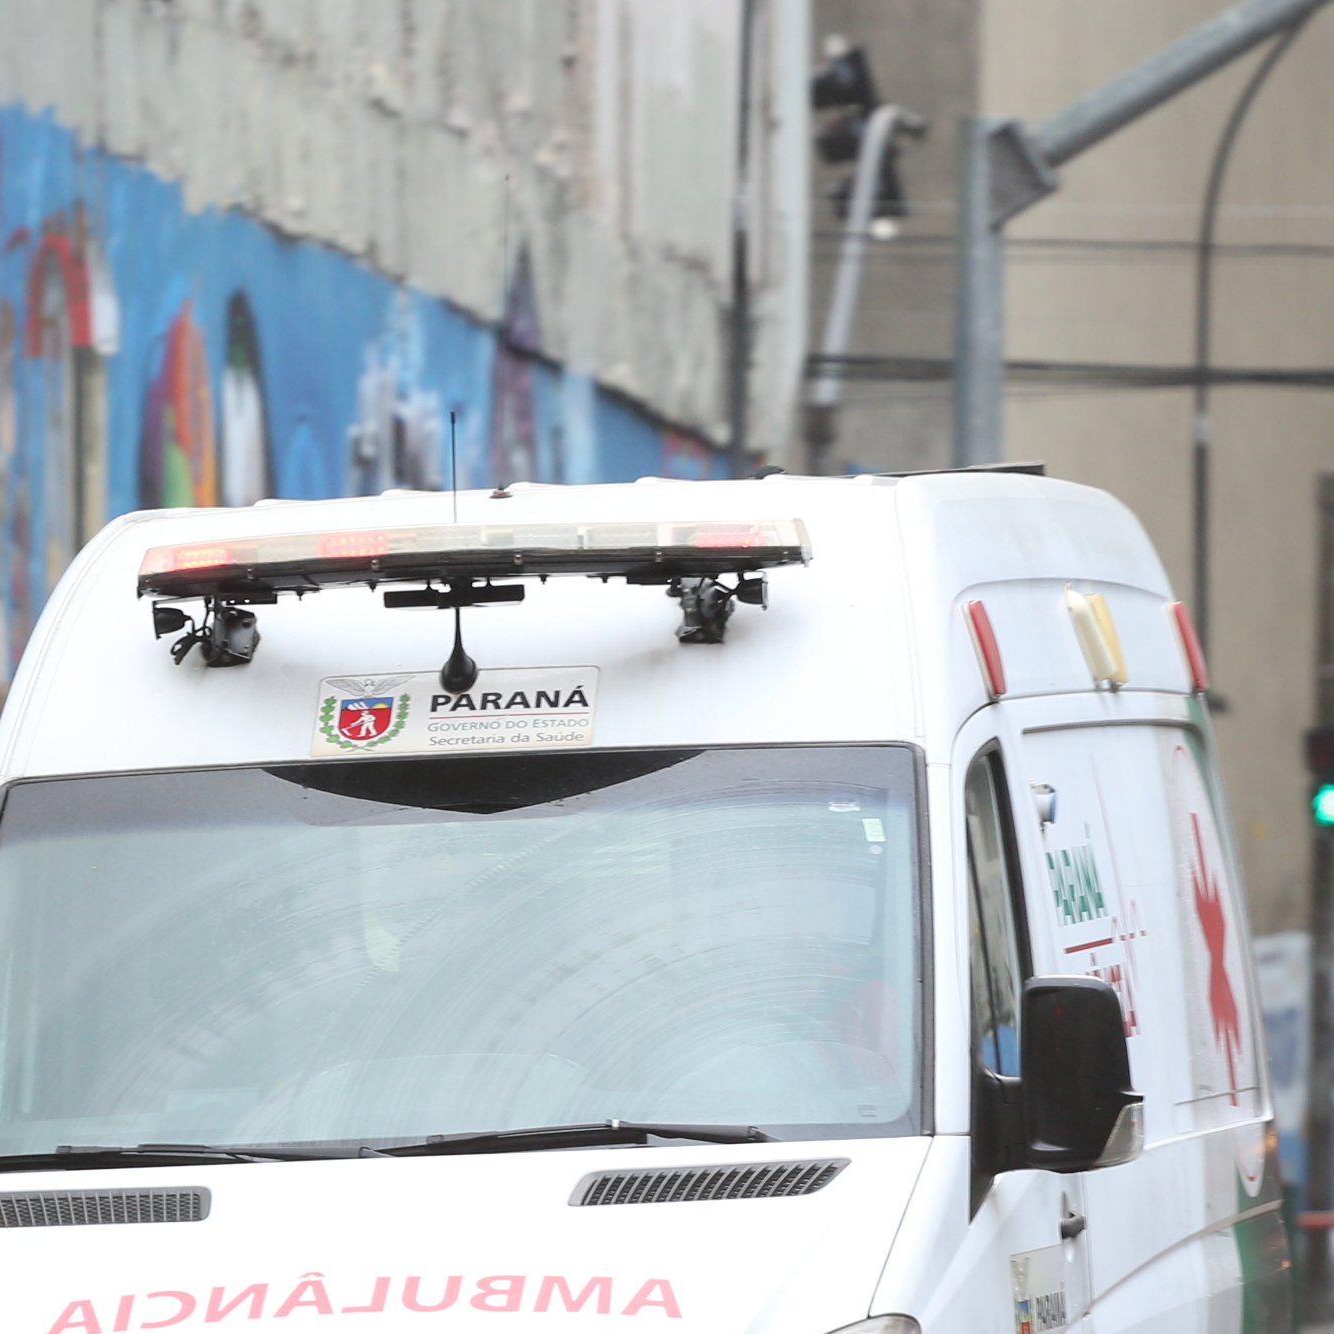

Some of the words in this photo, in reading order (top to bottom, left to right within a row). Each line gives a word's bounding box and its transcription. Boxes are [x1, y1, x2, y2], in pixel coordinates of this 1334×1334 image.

[429, 684, 590, 713] PARANÁ
[427, 720, 501, 732] GOVERNO
[505, 720, 528, 730] DO
[532, 718, 590, 729] ESTADO
[429, 734, 506, 747] Secretaria
[510, 732, 531, 744] da
[535, 731, 585, 743] Saúde
